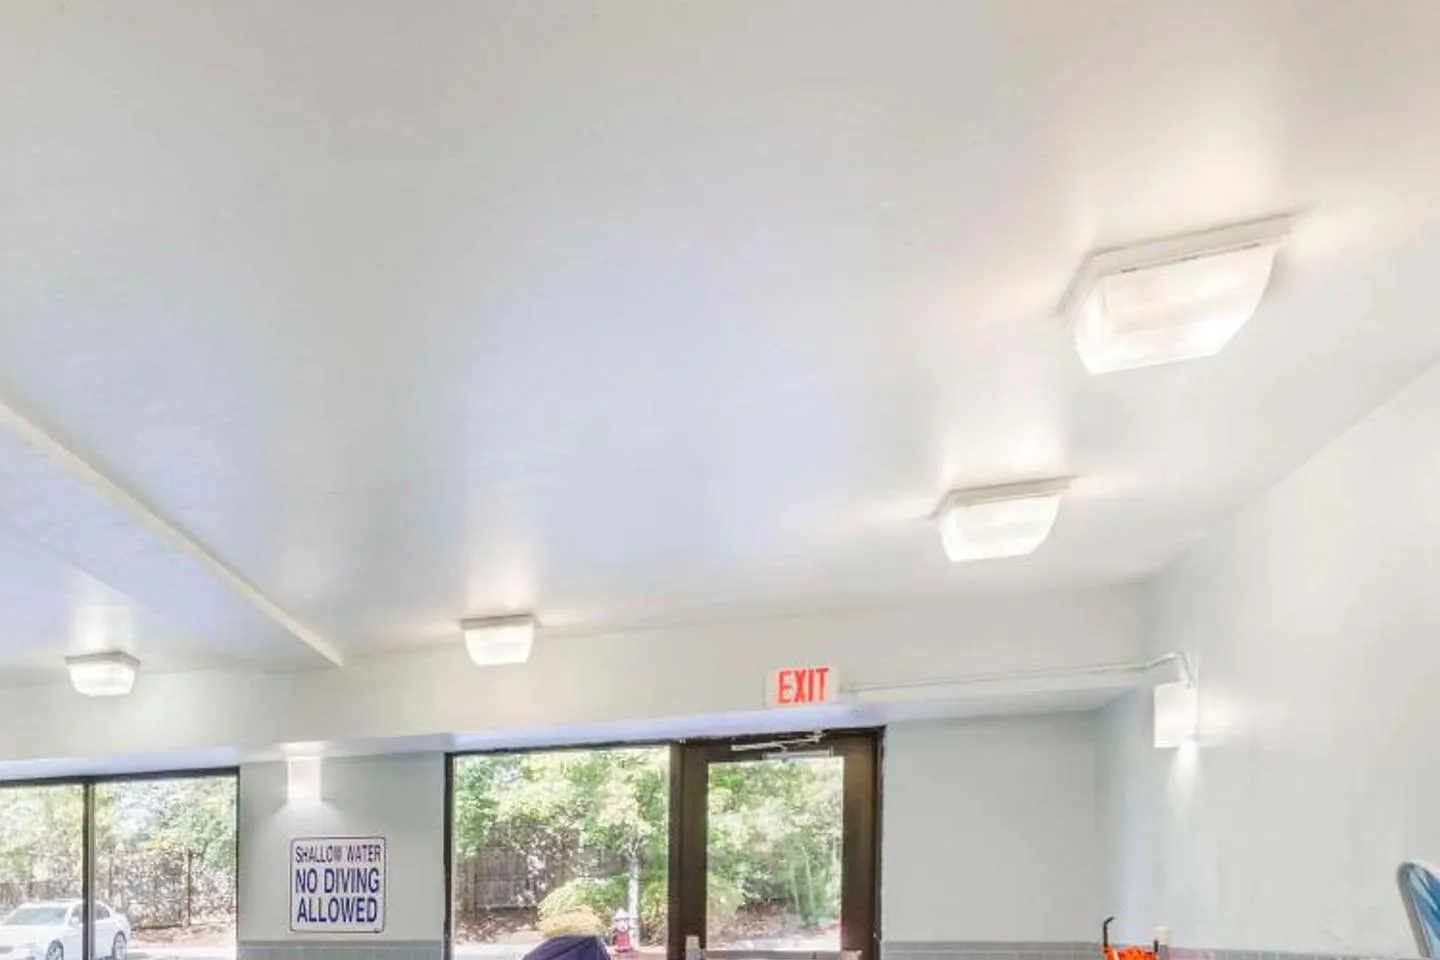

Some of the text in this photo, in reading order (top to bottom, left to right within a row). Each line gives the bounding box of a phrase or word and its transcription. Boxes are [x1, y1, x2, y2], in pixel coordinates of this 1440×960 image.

[779, 667, 829, 703] EXIT
[296, 844, 381, 863] SHALLOW WATER
[296, 867, 379, 893] NO DIVING
[297, 896, 377, 922] ALLOWED
